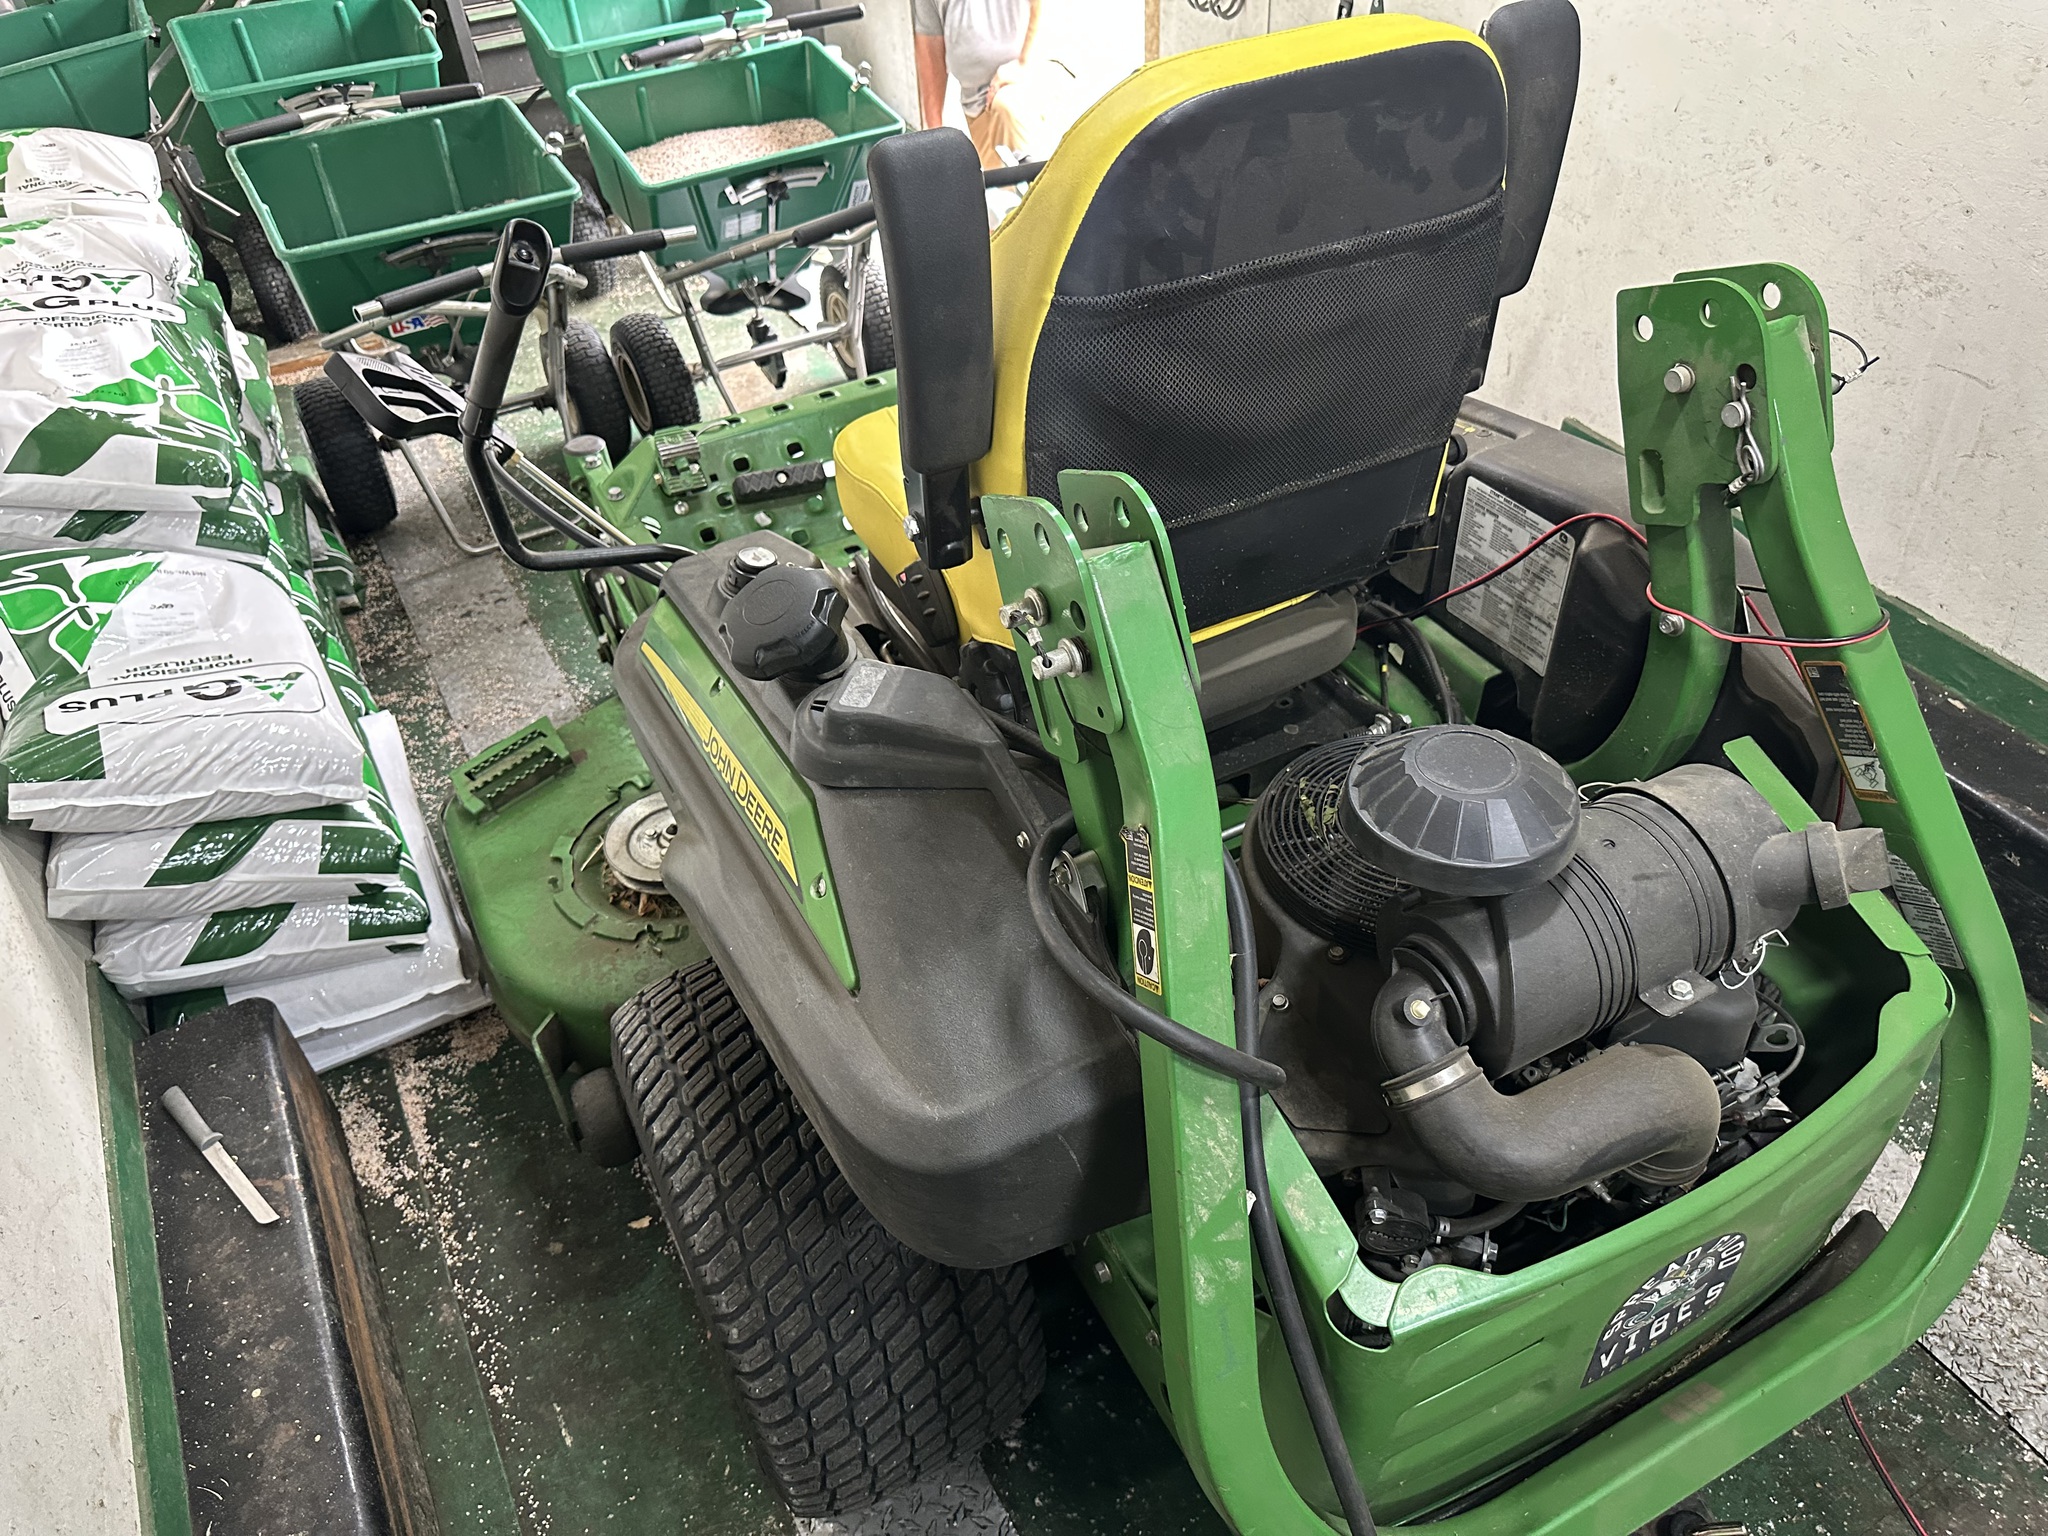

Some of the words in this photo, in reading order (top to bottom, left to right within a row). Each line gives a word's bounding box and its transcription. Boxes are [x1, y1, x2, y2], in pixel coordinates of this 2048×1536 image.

[26, 313, 139, 323] OFESSIONAL
[89, 299, 178, 318] PLUS
[391, 316, 425, 334] USA
[108, 657, 254, 683] PROFESSIONAL
[125, 653, 234, 674] FERTILIZER
[58, 688, 173, 713] PLUS
[702, 726, 738, 794] JOHN
[736, 771, 784, 857] DEERE
[1603, 1246, 1703, 1342] SPREAD
[1707, 1234, 1746, 1271] GOOD
[1599, 1281, 1725, 1369] VIBES
